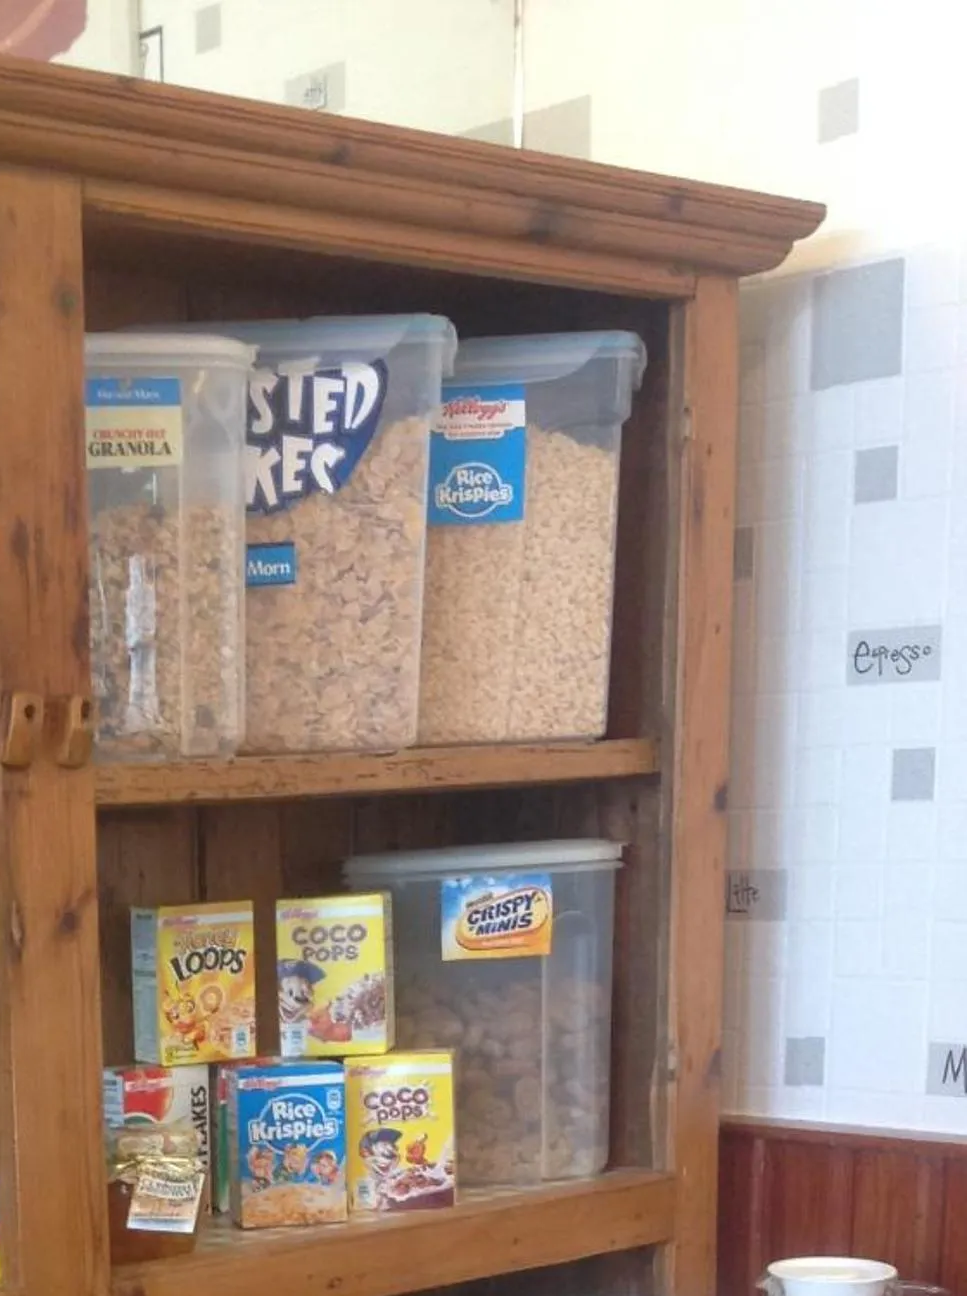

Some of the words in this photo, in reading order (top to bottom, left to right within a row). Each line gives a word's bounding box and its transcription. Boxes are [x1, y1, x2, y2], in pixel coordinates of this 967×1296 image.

[247, 356, 380, 435] STED
[88, 440, 173, 457] GRANOLA
[246, 435, 346, 508] KES
[456, 469, 493, 487] Rice
[438, 484, 510, 504] Krispies
[247, 560, 291, 576] Morn
[467, 890, 538, 925] CRISPY
[292, 923, 368, 945] COCO
[476, 913, 534, 936] MINIS
[301, 944, 360, 962] POPS
[170, 946, 247, 982] LOOPS
[364, 1087, 429, 1110] COCO
[272, 1101, 316, 1121] Rice
[251, 1120, 336, 1141] Krispies
